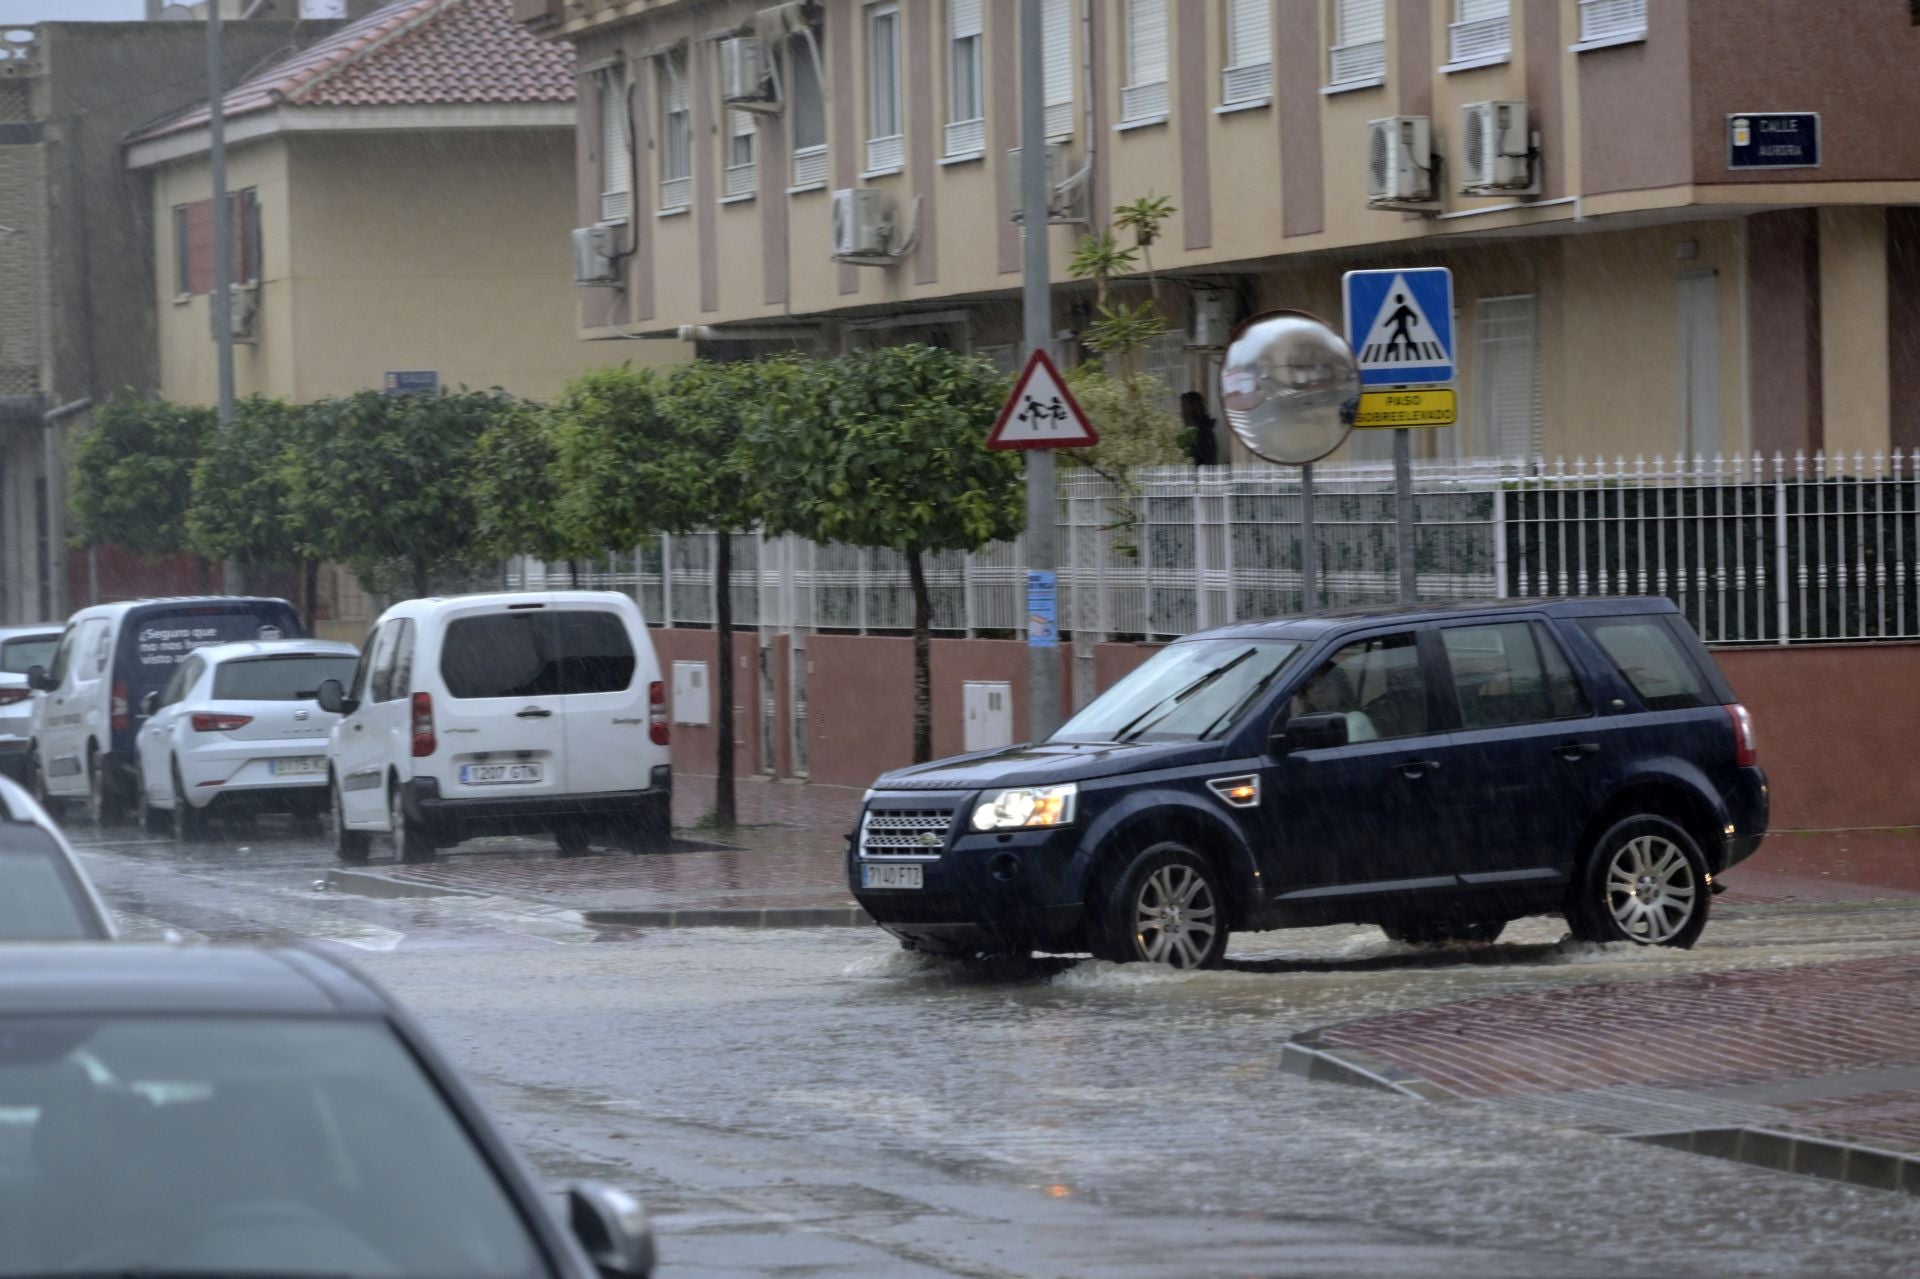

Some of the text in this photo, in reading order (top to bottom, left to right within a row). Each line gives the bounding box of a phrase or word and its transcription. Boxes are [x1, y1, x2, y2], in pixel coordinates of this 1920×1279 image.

[1385, 395, 1422, 407] PASO
[1356, 409, 1451, 423] SOBREELEVADO
[138, 628, 218, 641] ¿Seguro que
[139, 643, 158, 652] no
[160, 641, 184, 651] nos
[140, 654, 173, 665] visto
[472, 765, 506, 780] 1207
[899, 866, 920, 885] FTZ
